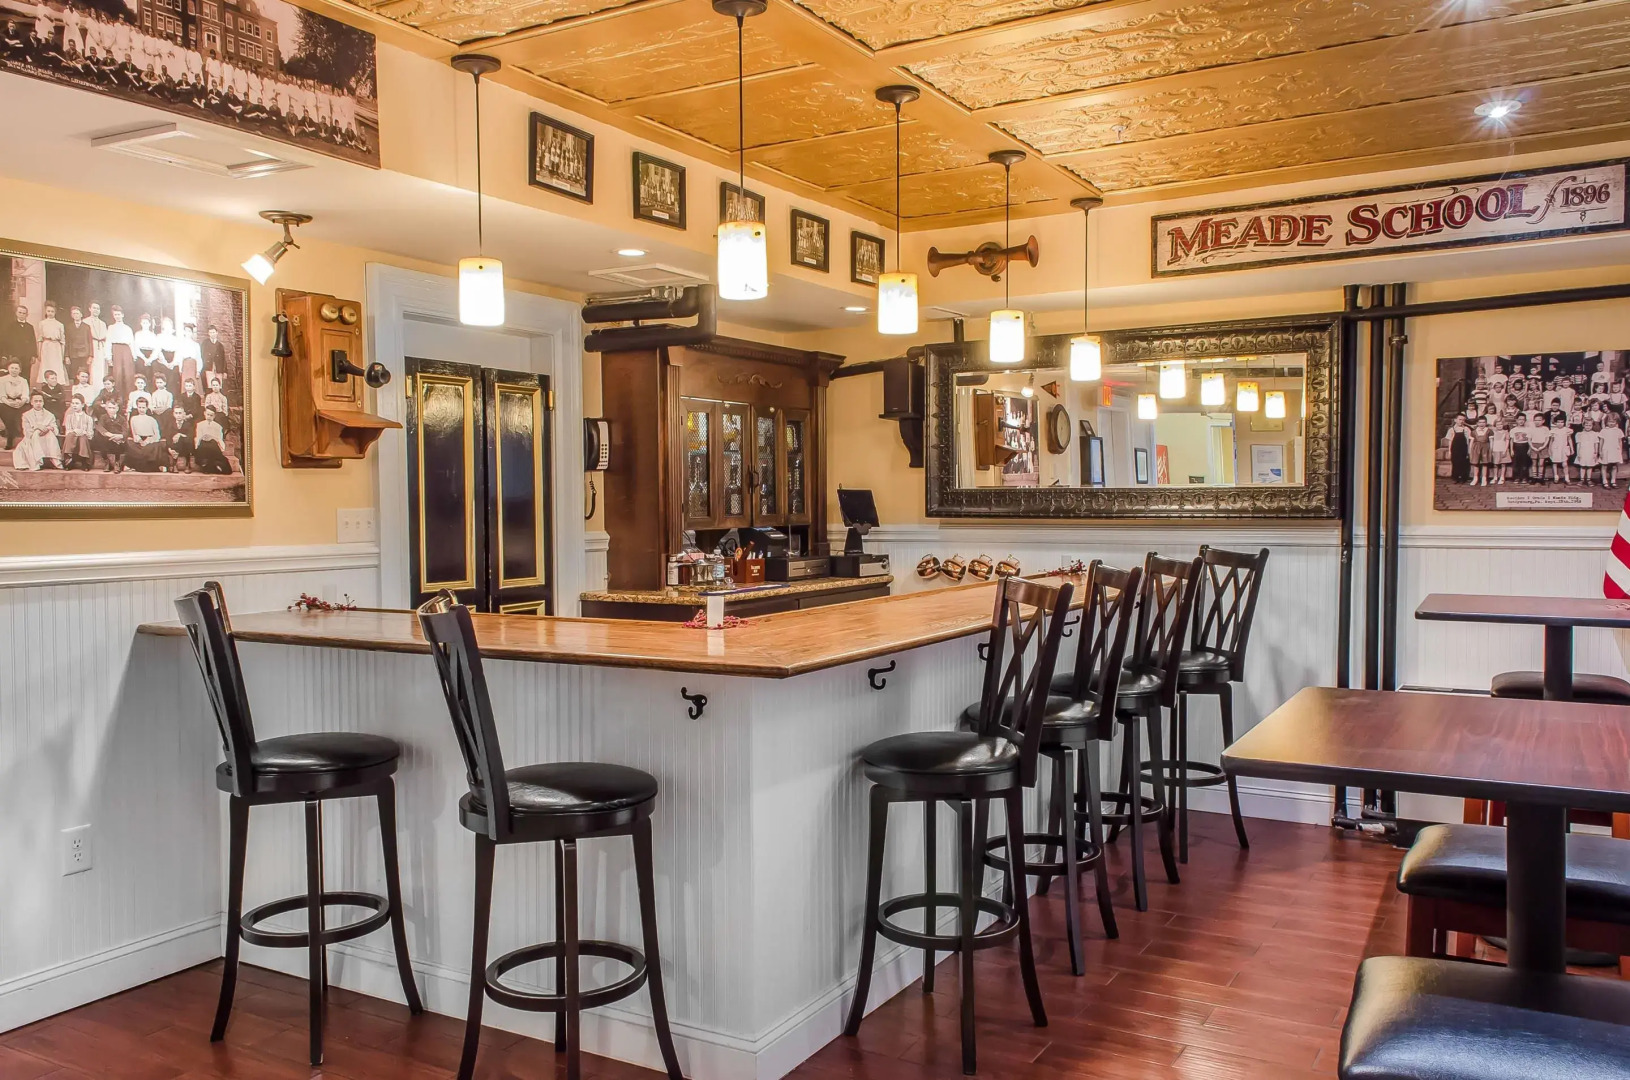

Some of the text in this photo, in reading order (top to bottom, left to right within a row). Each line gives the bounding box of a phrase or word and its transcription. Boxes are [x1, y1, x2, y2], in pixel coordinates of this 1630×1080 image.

[1560, 184, 1611, 208] 1896
[1167, 183, 1541, 266] MEADE SCHOOL
